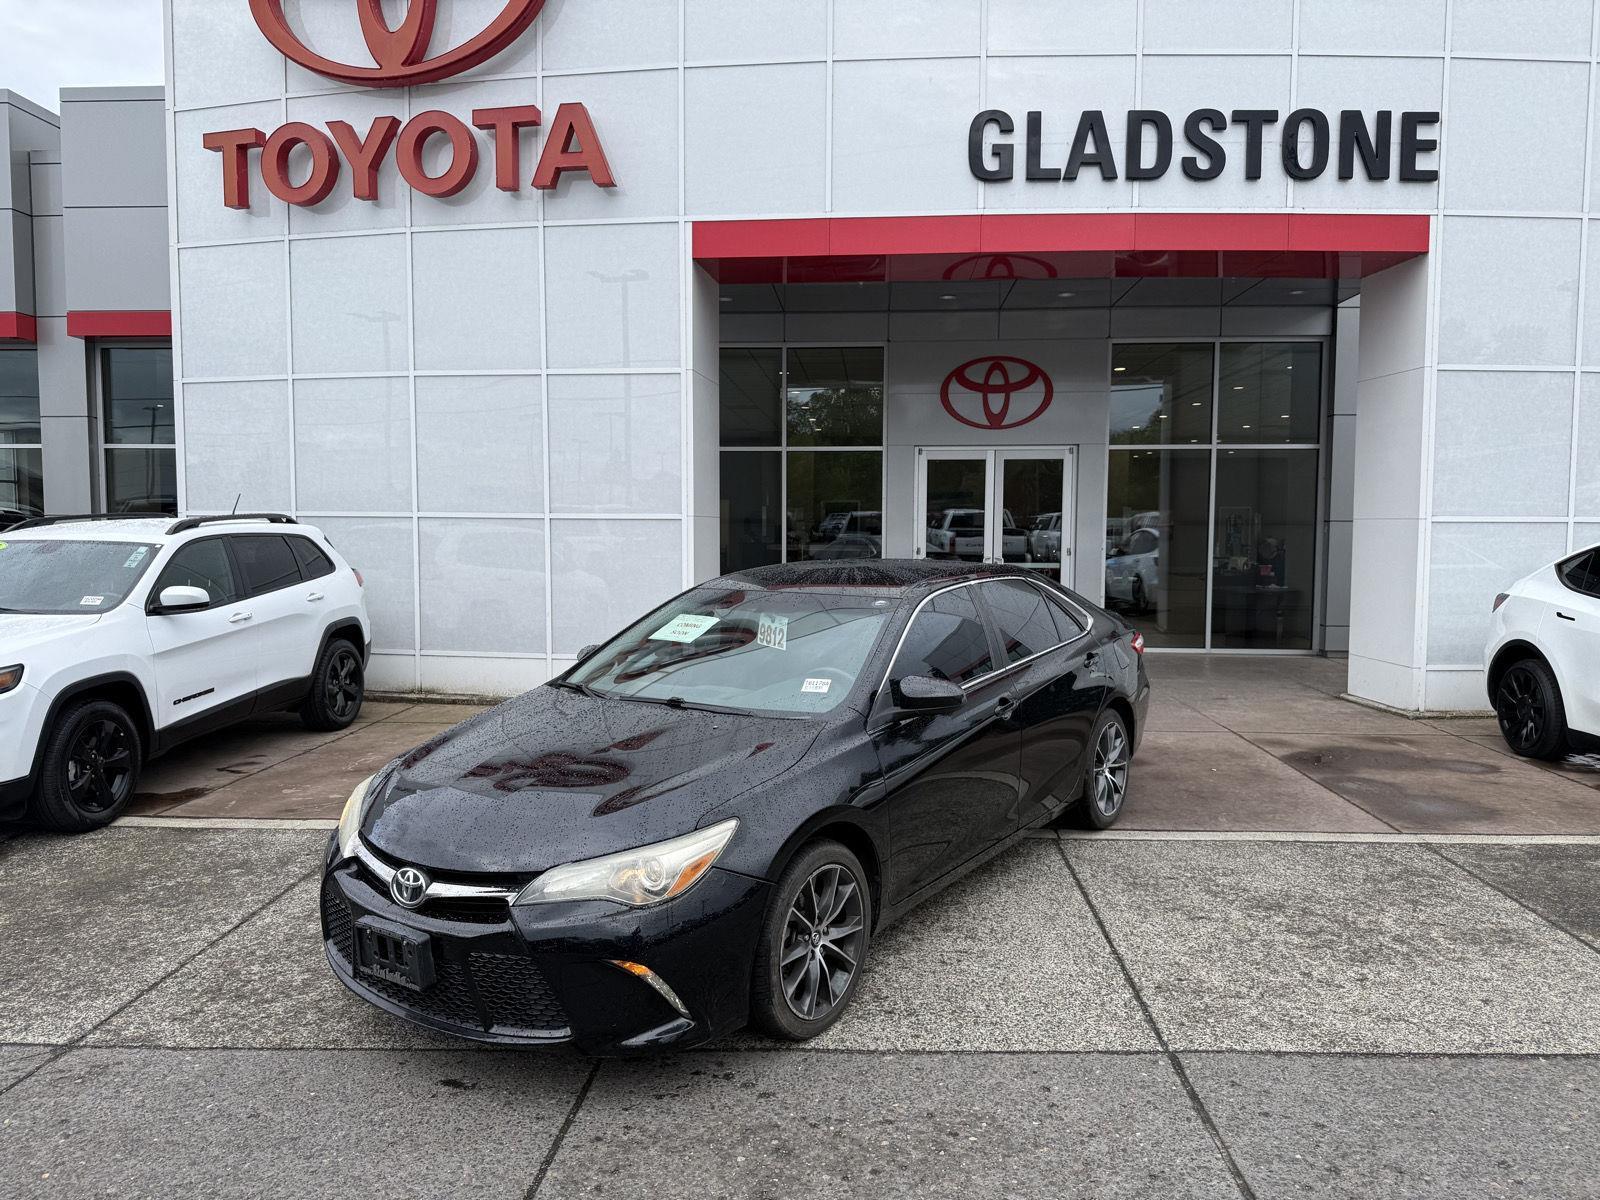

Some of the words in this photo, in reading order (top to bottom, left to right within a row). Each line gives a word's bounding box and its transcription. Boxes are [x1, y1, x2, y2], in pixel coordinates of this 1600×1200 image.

[203, 102, 617, 209] TOYOTA
[968, 108, 1440, 182] GLADSTONE
[759, 622, 785, 649] 9812
